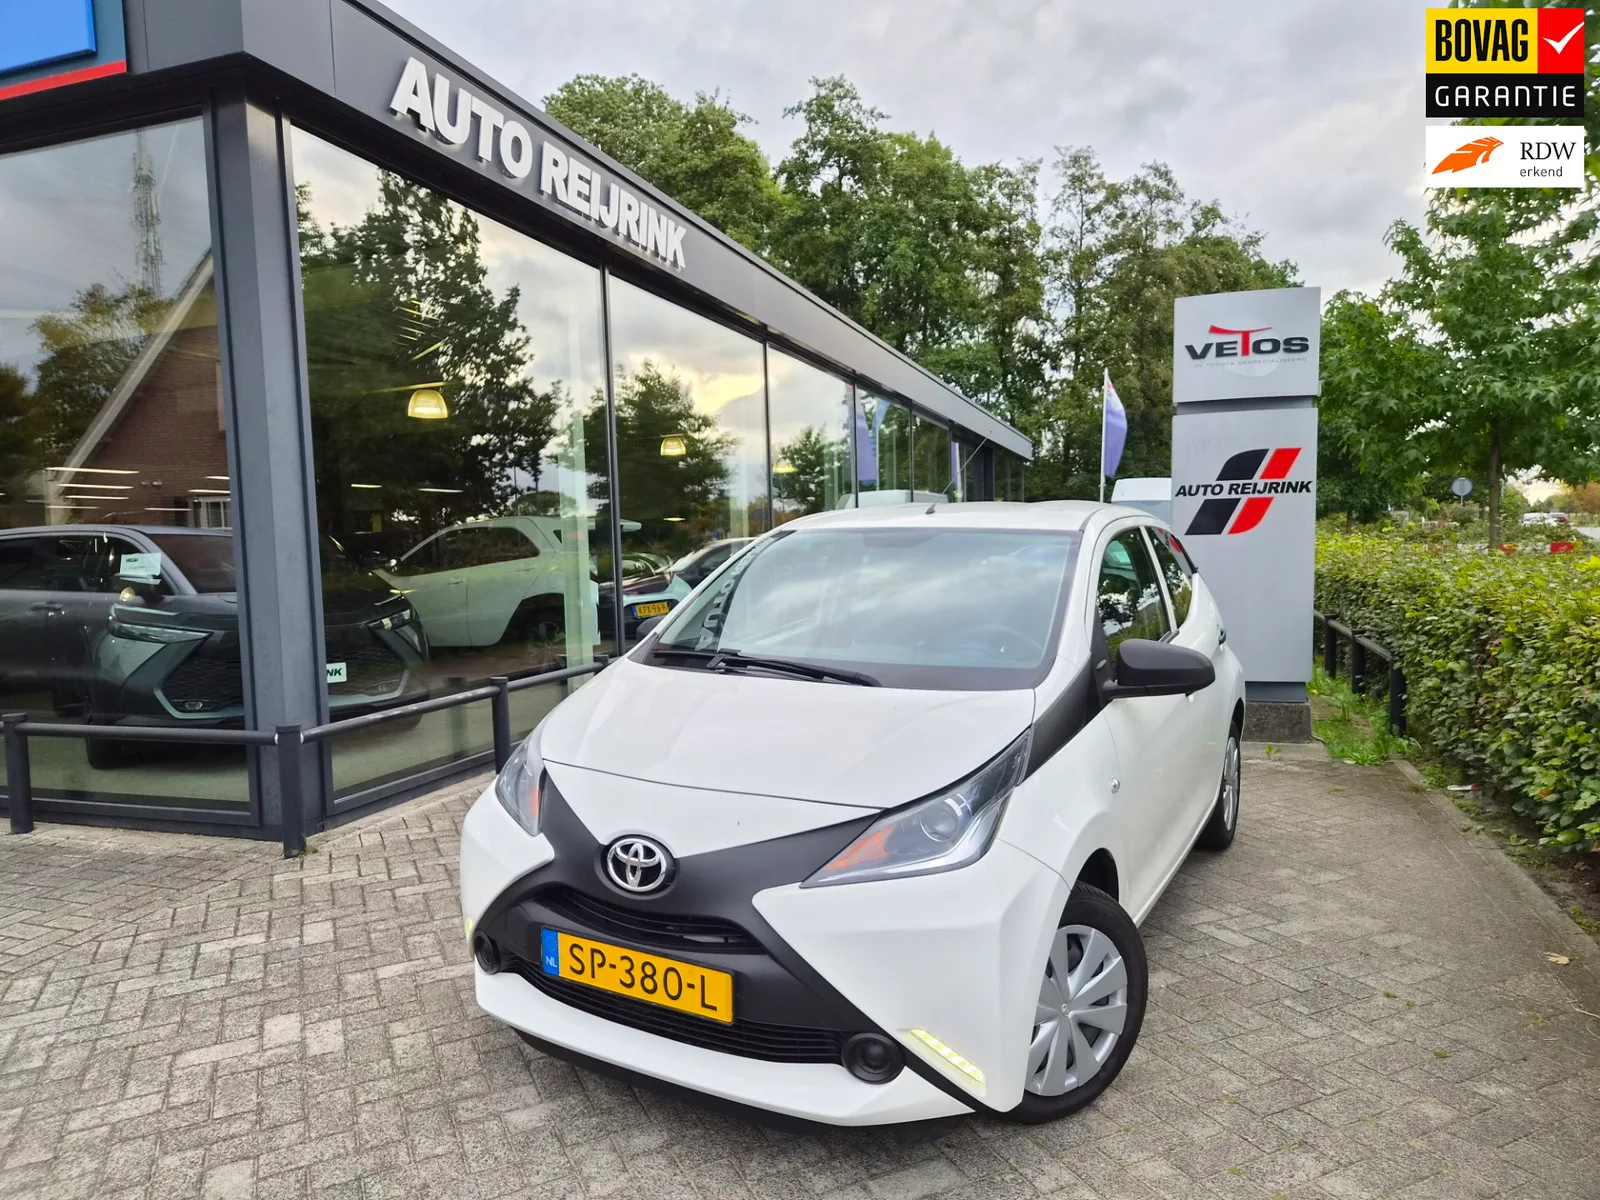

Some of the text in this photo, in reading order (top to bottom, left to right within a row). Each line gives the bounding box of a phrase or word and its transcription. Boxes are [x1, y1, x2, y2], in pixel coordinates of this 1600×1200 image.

[389, 56, 687, 269] AUTO REIJRINK
[1175, 481, 1313, 497] AUTO REIJRINK
[545, 943, 717, 1011] NL SP-380-L
